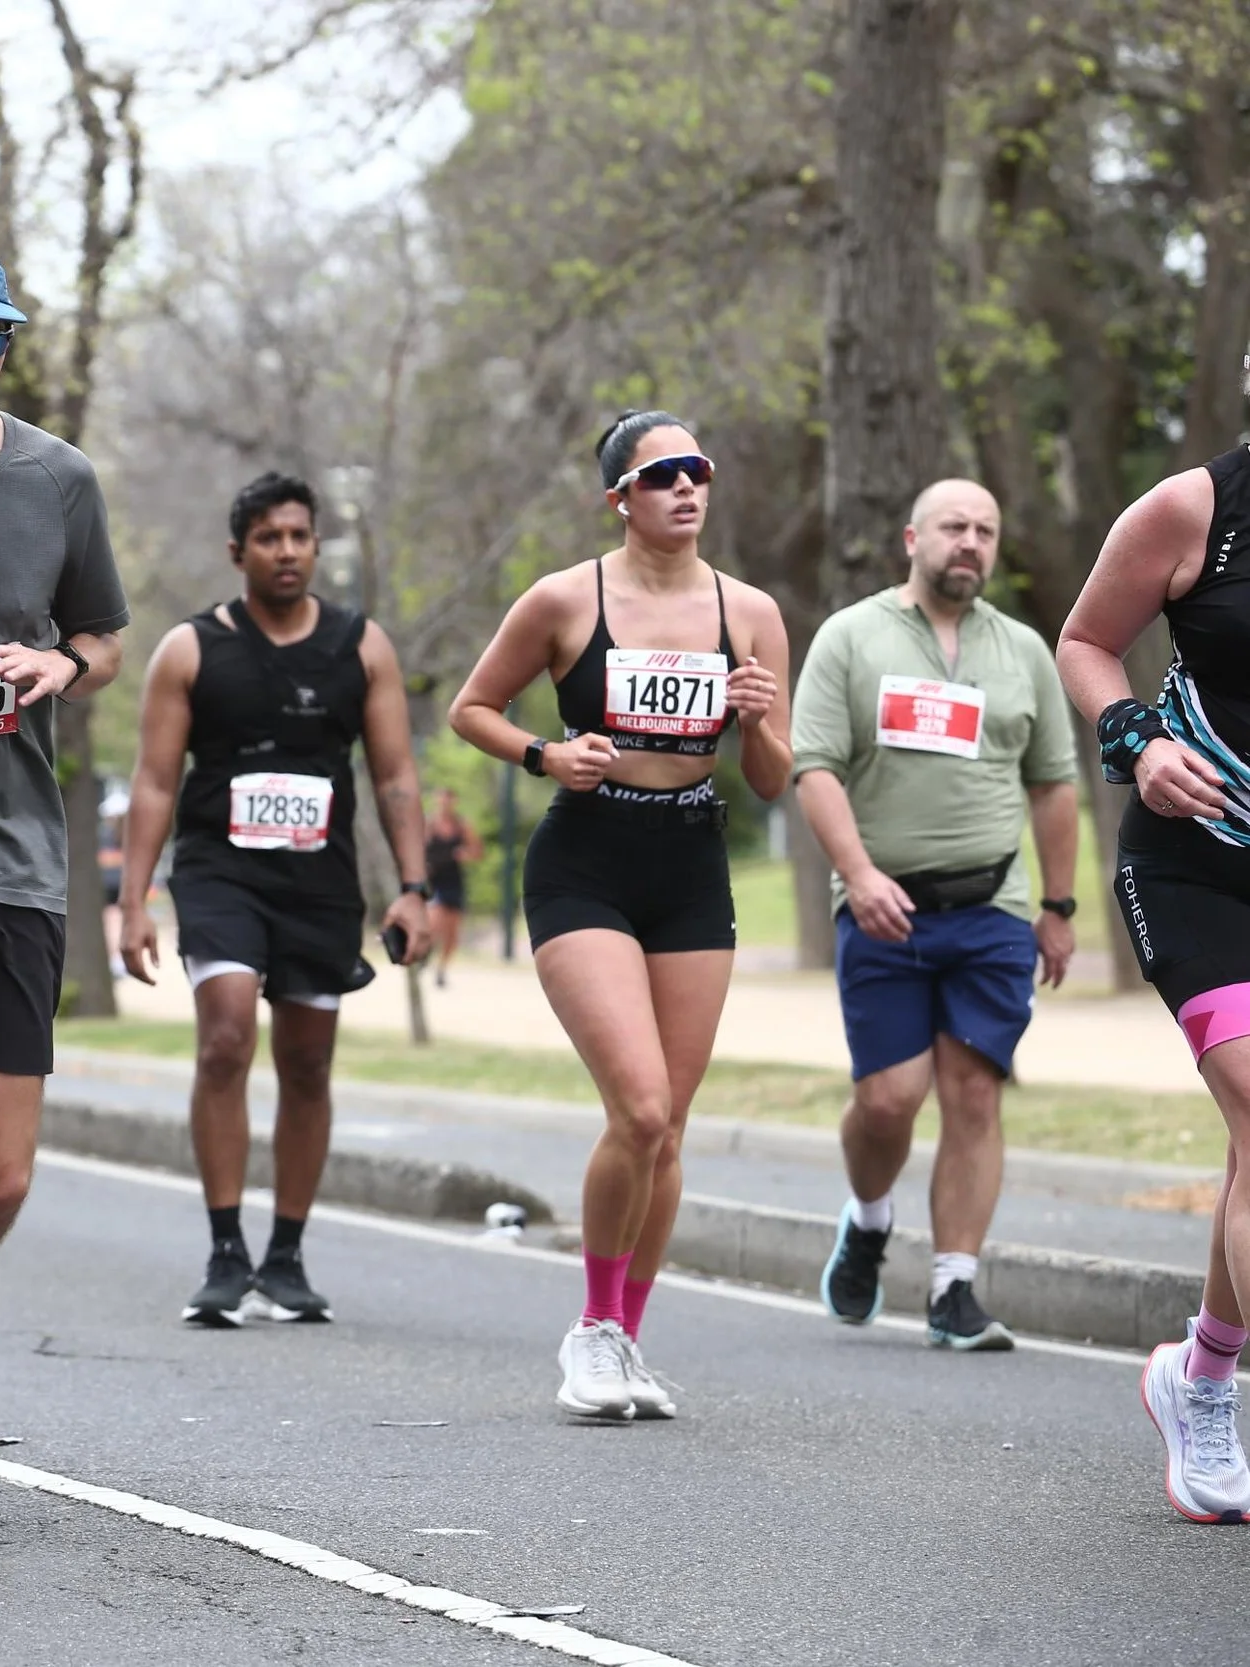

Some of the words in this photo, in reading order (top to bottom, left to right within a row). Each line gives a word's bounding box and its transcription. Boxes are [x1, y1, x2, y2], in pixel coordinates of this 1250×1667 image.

[626, 674, 714, 717] 14871
[616, 716, 684, 732] MELBOURNE
[687, 720, 713, 733] 2025
[610, 734, 646, 748] NIKE
[678, 739, 707, 754] NIKE
[247, 795, 319, 825] 12835
